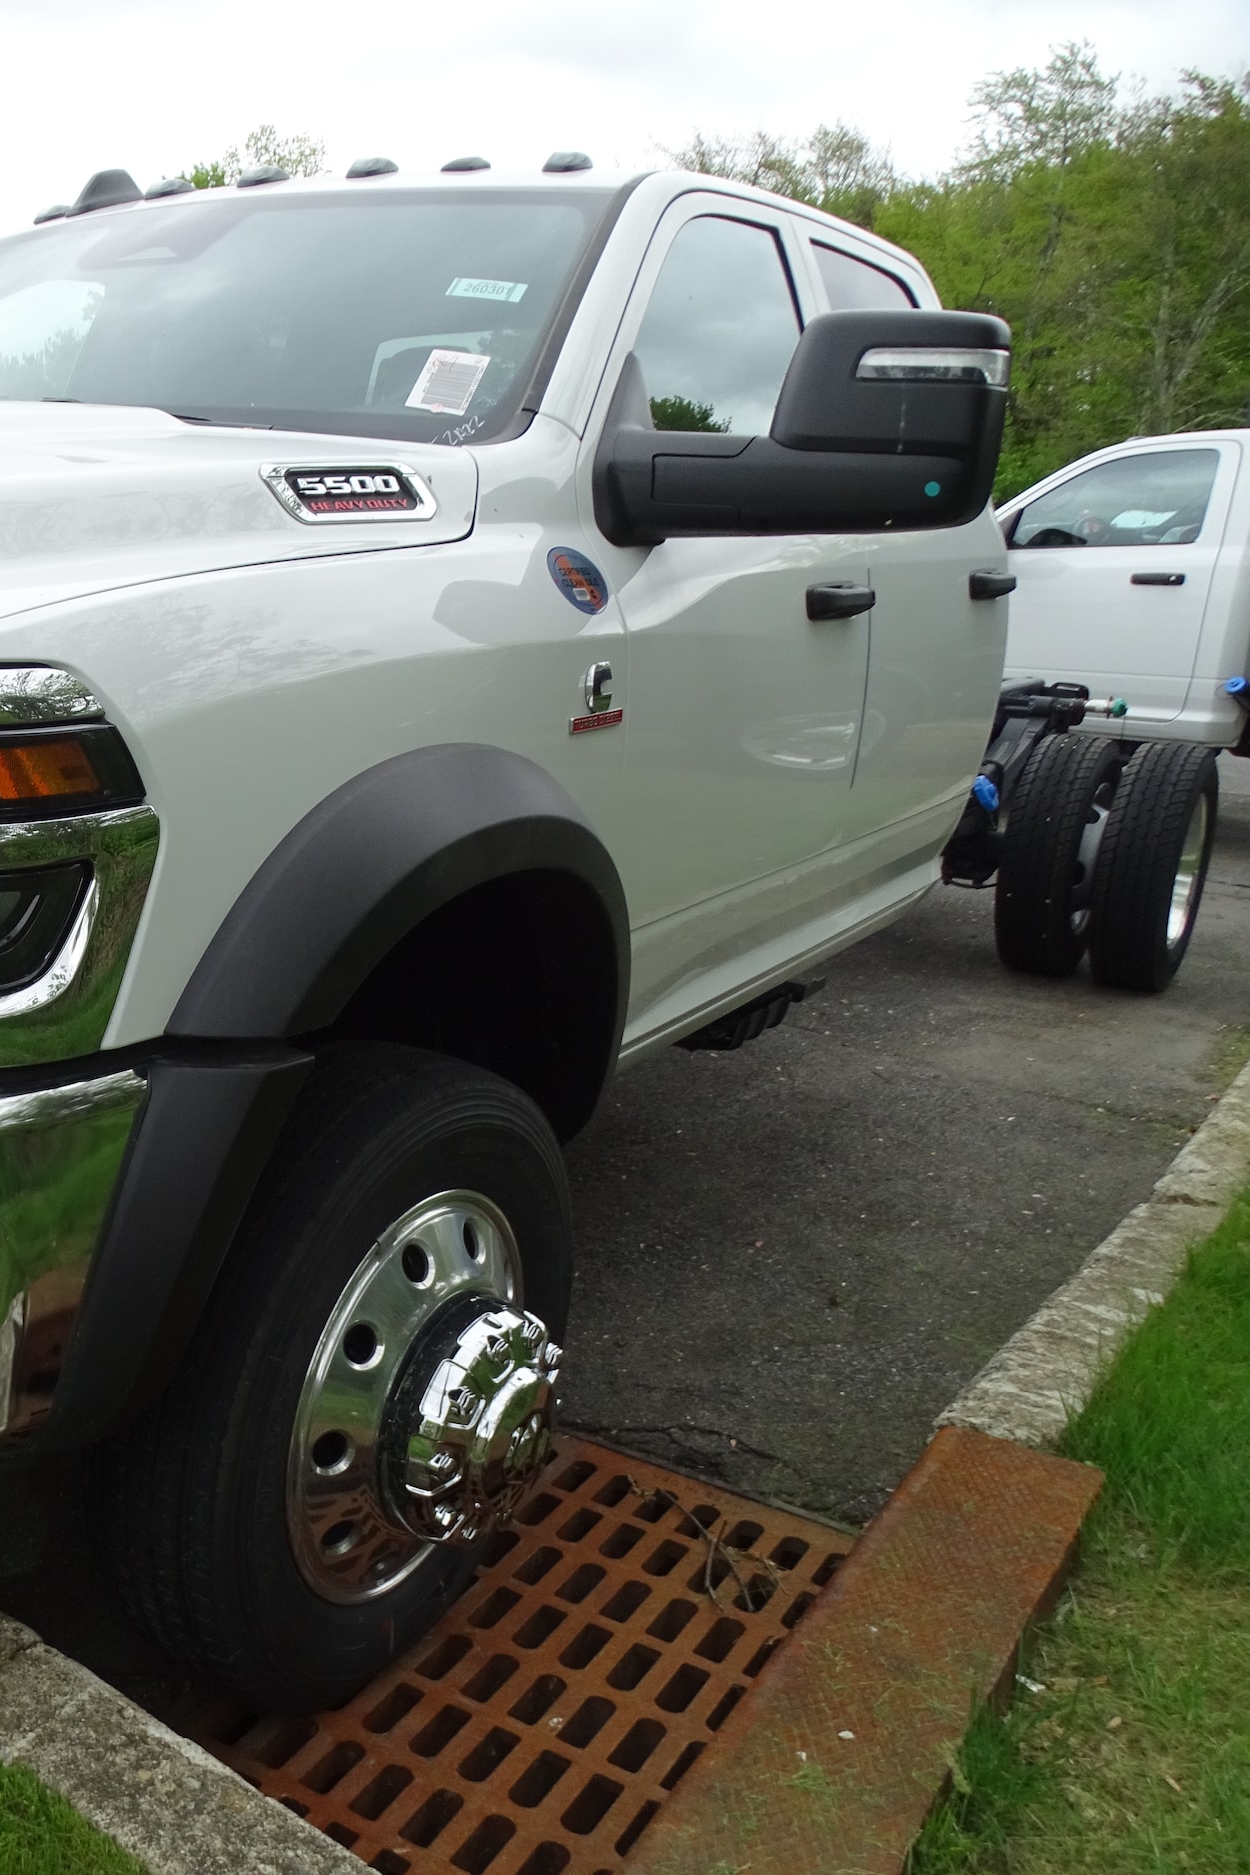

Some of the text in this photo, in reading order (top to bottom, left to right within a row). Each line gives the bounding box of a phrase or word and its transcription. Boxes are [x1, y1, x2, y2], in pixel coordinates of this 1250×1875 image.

[297, 475, 401, 495] 5500
[310, 499, 407, 511] HEAVY DUTY
